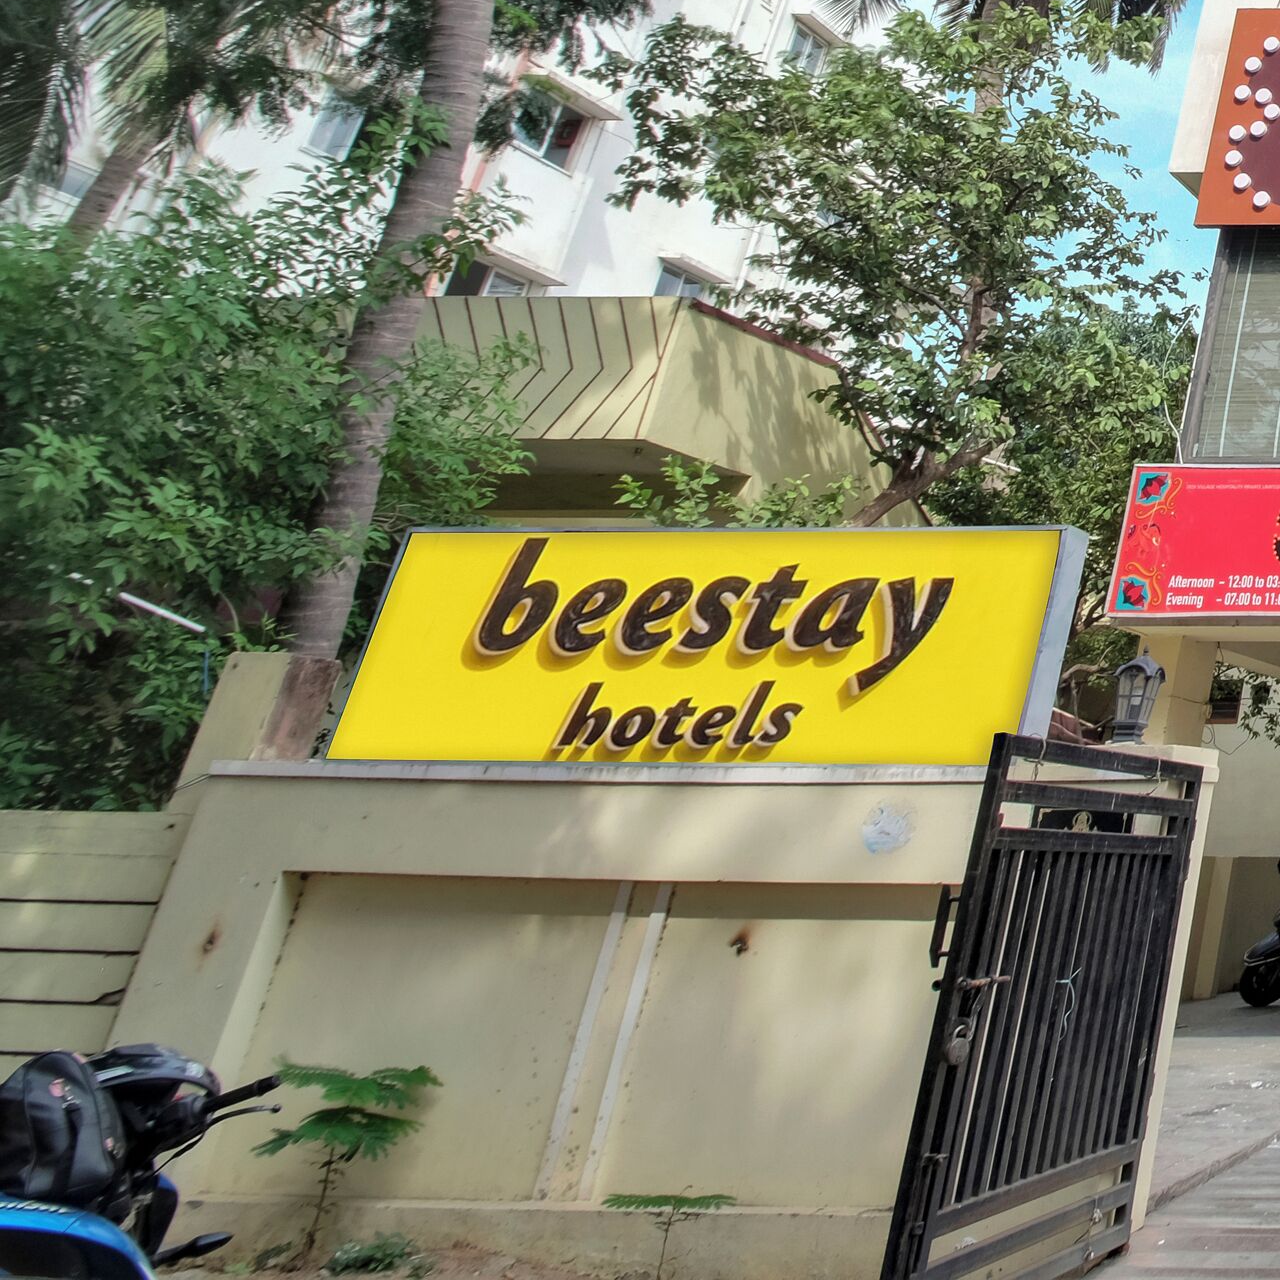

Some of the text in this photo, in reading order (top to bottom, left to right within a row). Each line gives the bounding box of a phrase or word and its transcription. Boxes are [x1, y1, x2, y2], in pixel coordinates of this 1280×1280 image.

[1166, 592, 1204, 608] Evening
[1224, 593, 1250, 606] 07:00
[1252, 593, 1262, 606] to
[1168, 575, 1215, 588] Afternoon
[1228, 575, 1254, 588] 12:00
[1254, 576, 1264, 588] to
[470, 537, 955, 696] beestay
[551, 679, 804, 753] hotels
